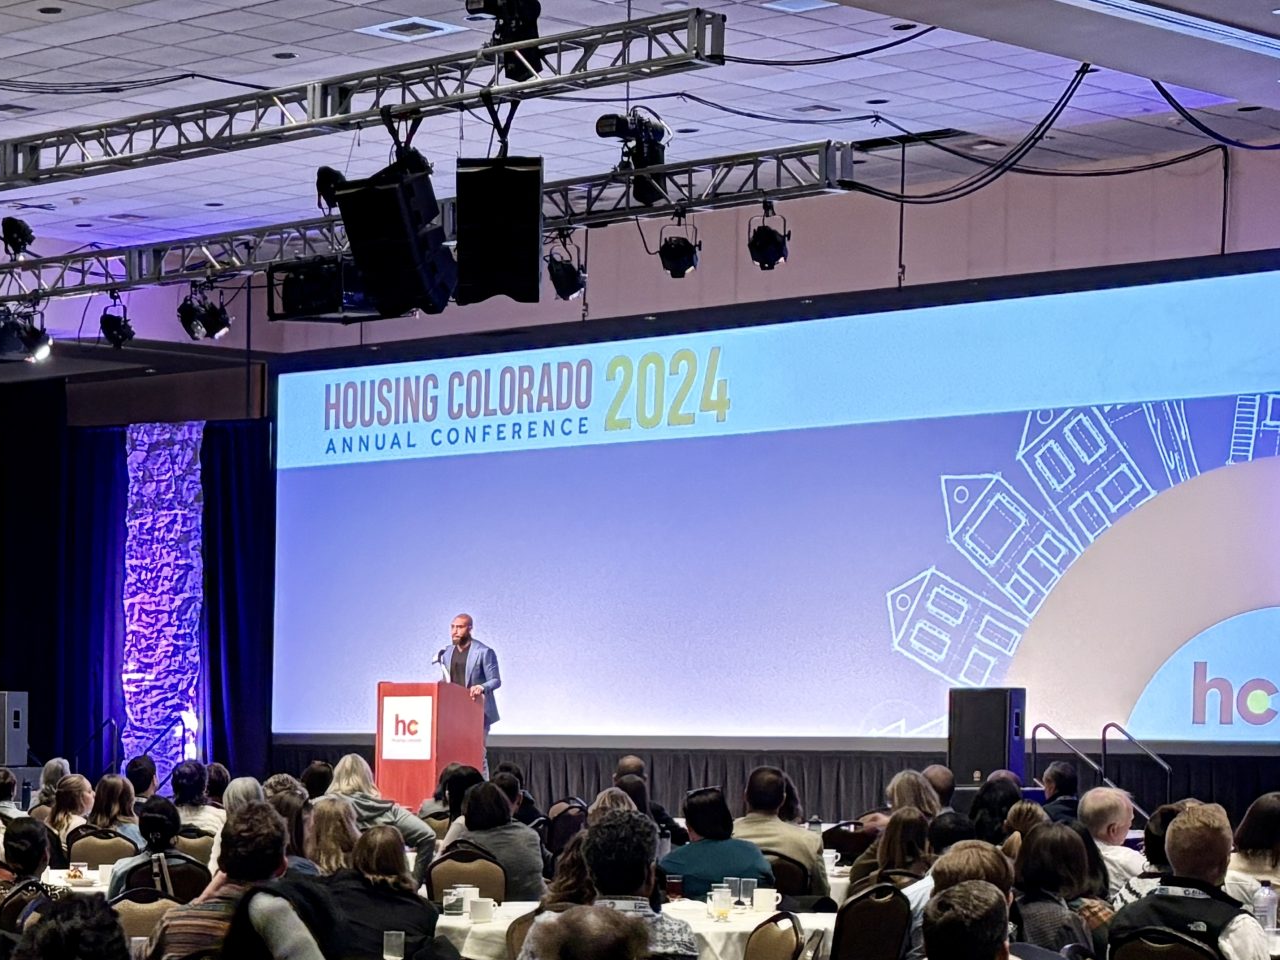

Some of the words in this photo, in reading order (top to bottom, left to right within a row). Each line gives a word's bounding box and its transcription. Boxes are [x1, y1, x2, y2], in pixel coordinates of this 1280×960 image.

[324, 373, 439, 431] HOUSING
[447, 359, 593, 421] COLORADO
[604, 346, 731, 432] 2024
[325, 431, 417, 455] ANNUAL
[431, 417, 589, 446] CONFERENCE
[1191, 661, 1280, 726] hc
[393, 713, 419, 736] hc
